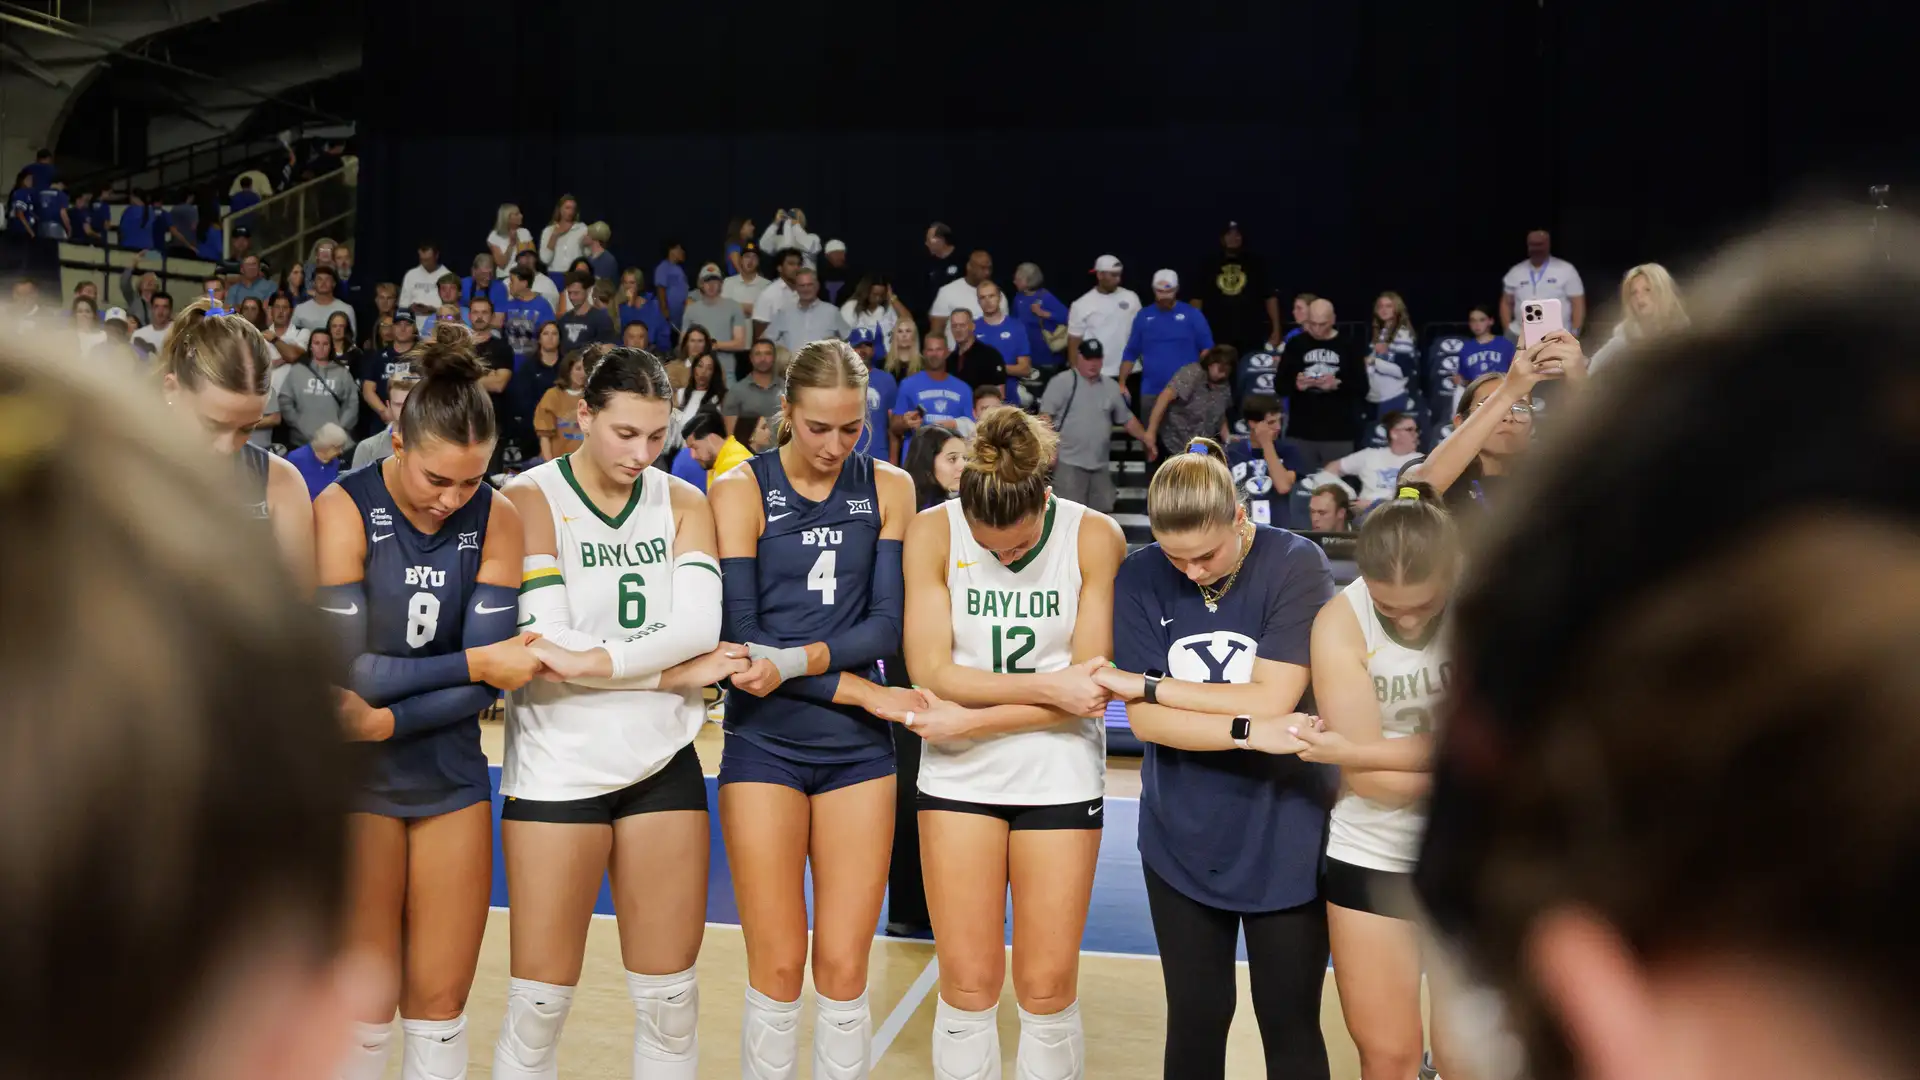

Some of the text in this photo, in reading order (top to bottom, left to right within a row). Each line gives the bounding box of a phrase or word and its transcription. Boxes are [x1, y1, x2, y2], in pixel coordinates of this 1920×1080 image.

[580, 538, 668, 568] BAYLOR
[802, 527, 843, 547] BYU
[405, 565, 446, 589] BYU
[807, 550, 837, 605] 4
[405, 591, 441, 649] 8
[617, 573, 646, 629] 6
[967, 588, 1060, 618] BAYLOR
[991, 625, 1036, 674] 12
[1182, 639, 1248, 683] Y
